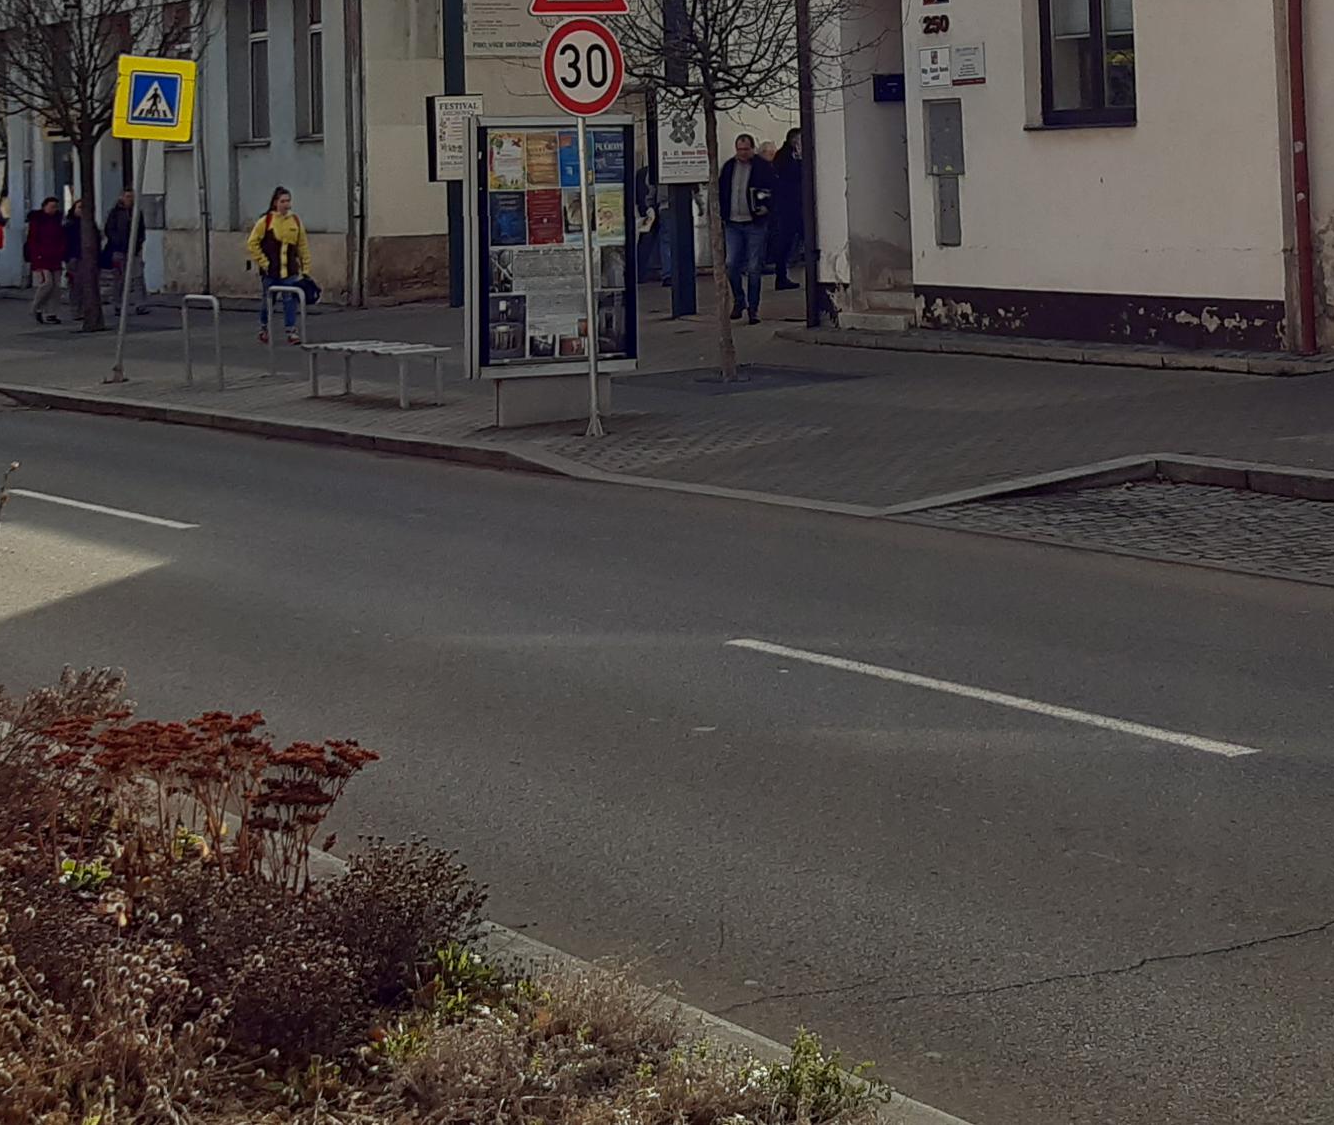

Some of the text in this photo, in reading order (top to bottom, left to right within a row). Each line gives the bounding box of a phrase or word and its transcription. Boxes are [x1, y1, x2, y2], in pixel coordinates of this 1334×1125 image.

[923, 15, 949, 34] 250
[559, 43, 608, 89] 30
[439, 101, 478, 111] FESTIVAL
